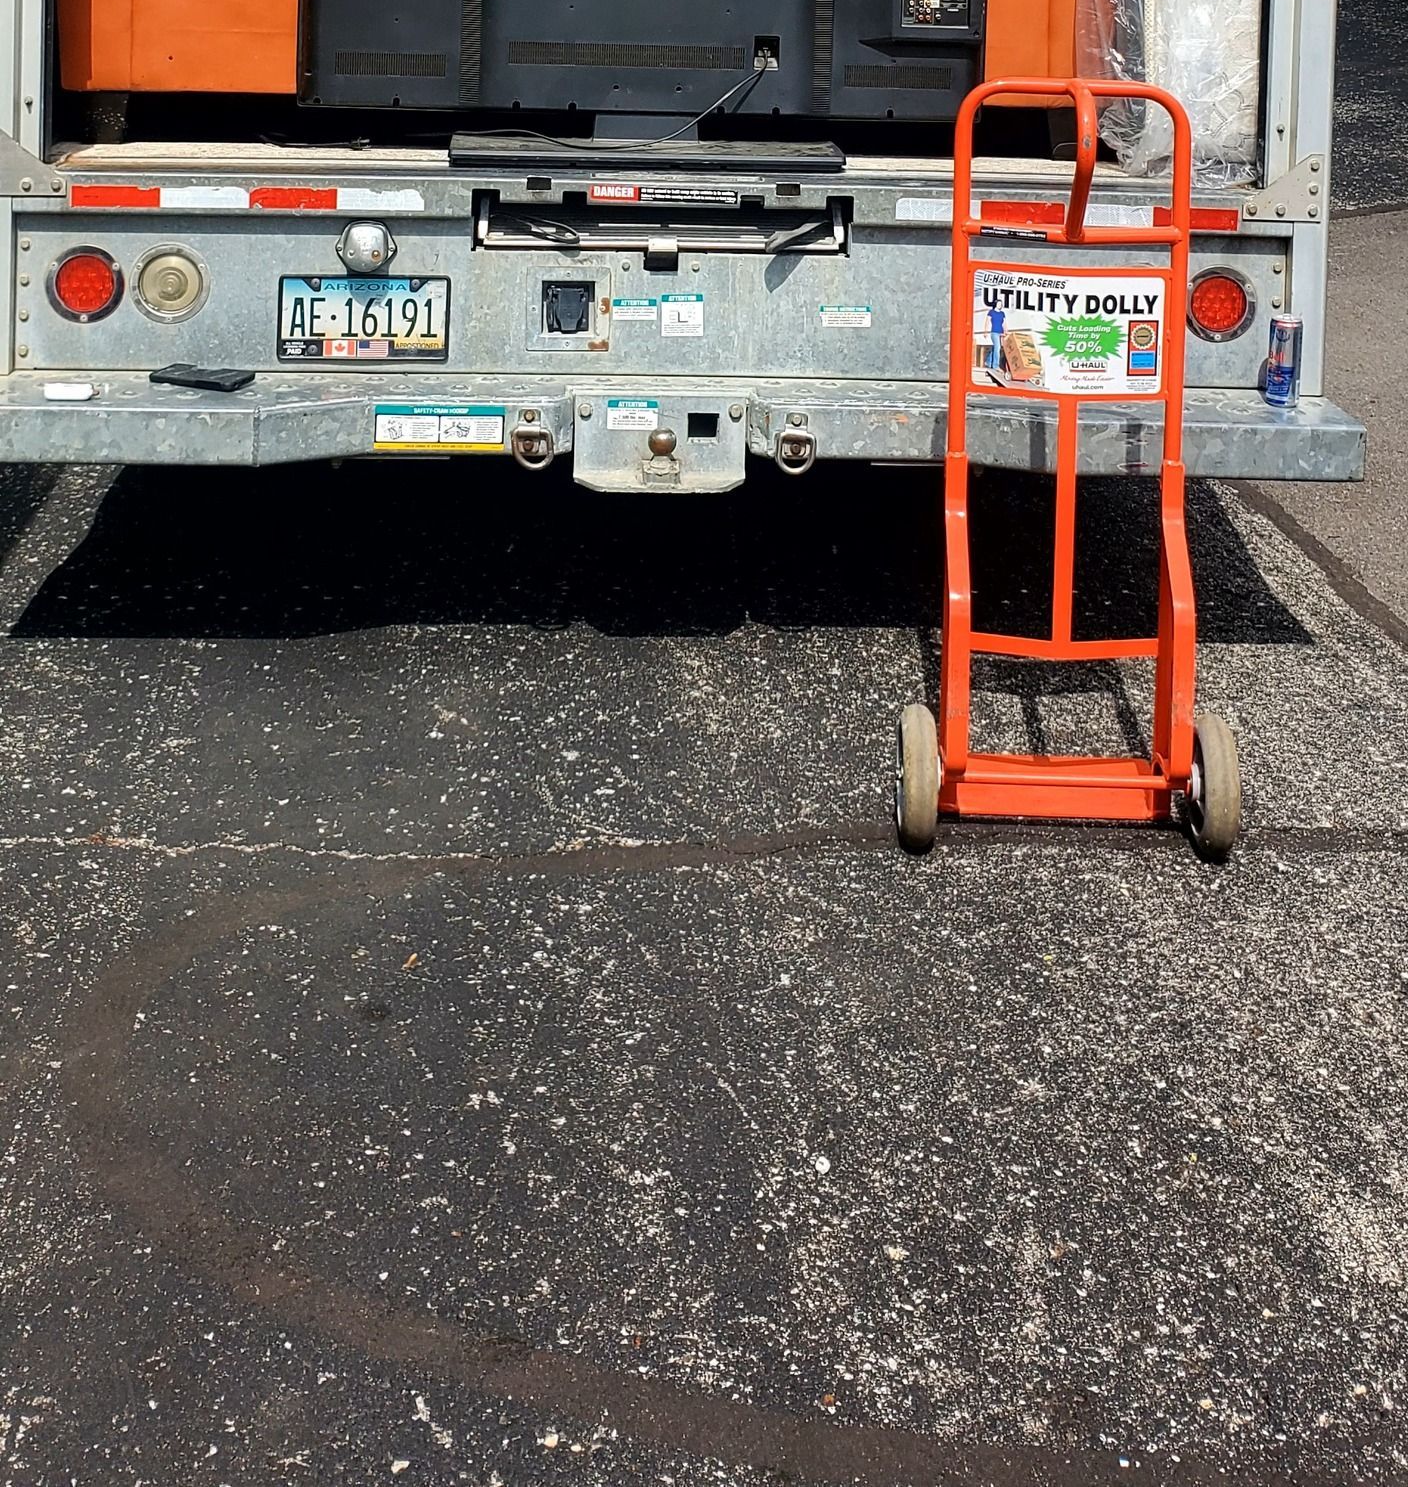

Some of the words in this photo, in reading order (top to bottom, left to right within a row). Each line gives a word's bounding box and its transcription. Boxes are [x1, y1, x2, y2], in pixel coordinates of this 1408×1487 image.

[593, 185, 635, 198] DANGER
[324, 283, 407, 292] ARIZONA
[1016, 276, 1066, 290] PRO-SERIES
[983, 287, 1079, 315] UTILITY
[1085, 294, 1159, 316] DOLLY
[1057, 324, 1077, 332] Cuts
[1079, 325, 1111, 333] Loading
[1090, 332, 1101, 340] by
[1064, 341, 1102, 353] 50%
